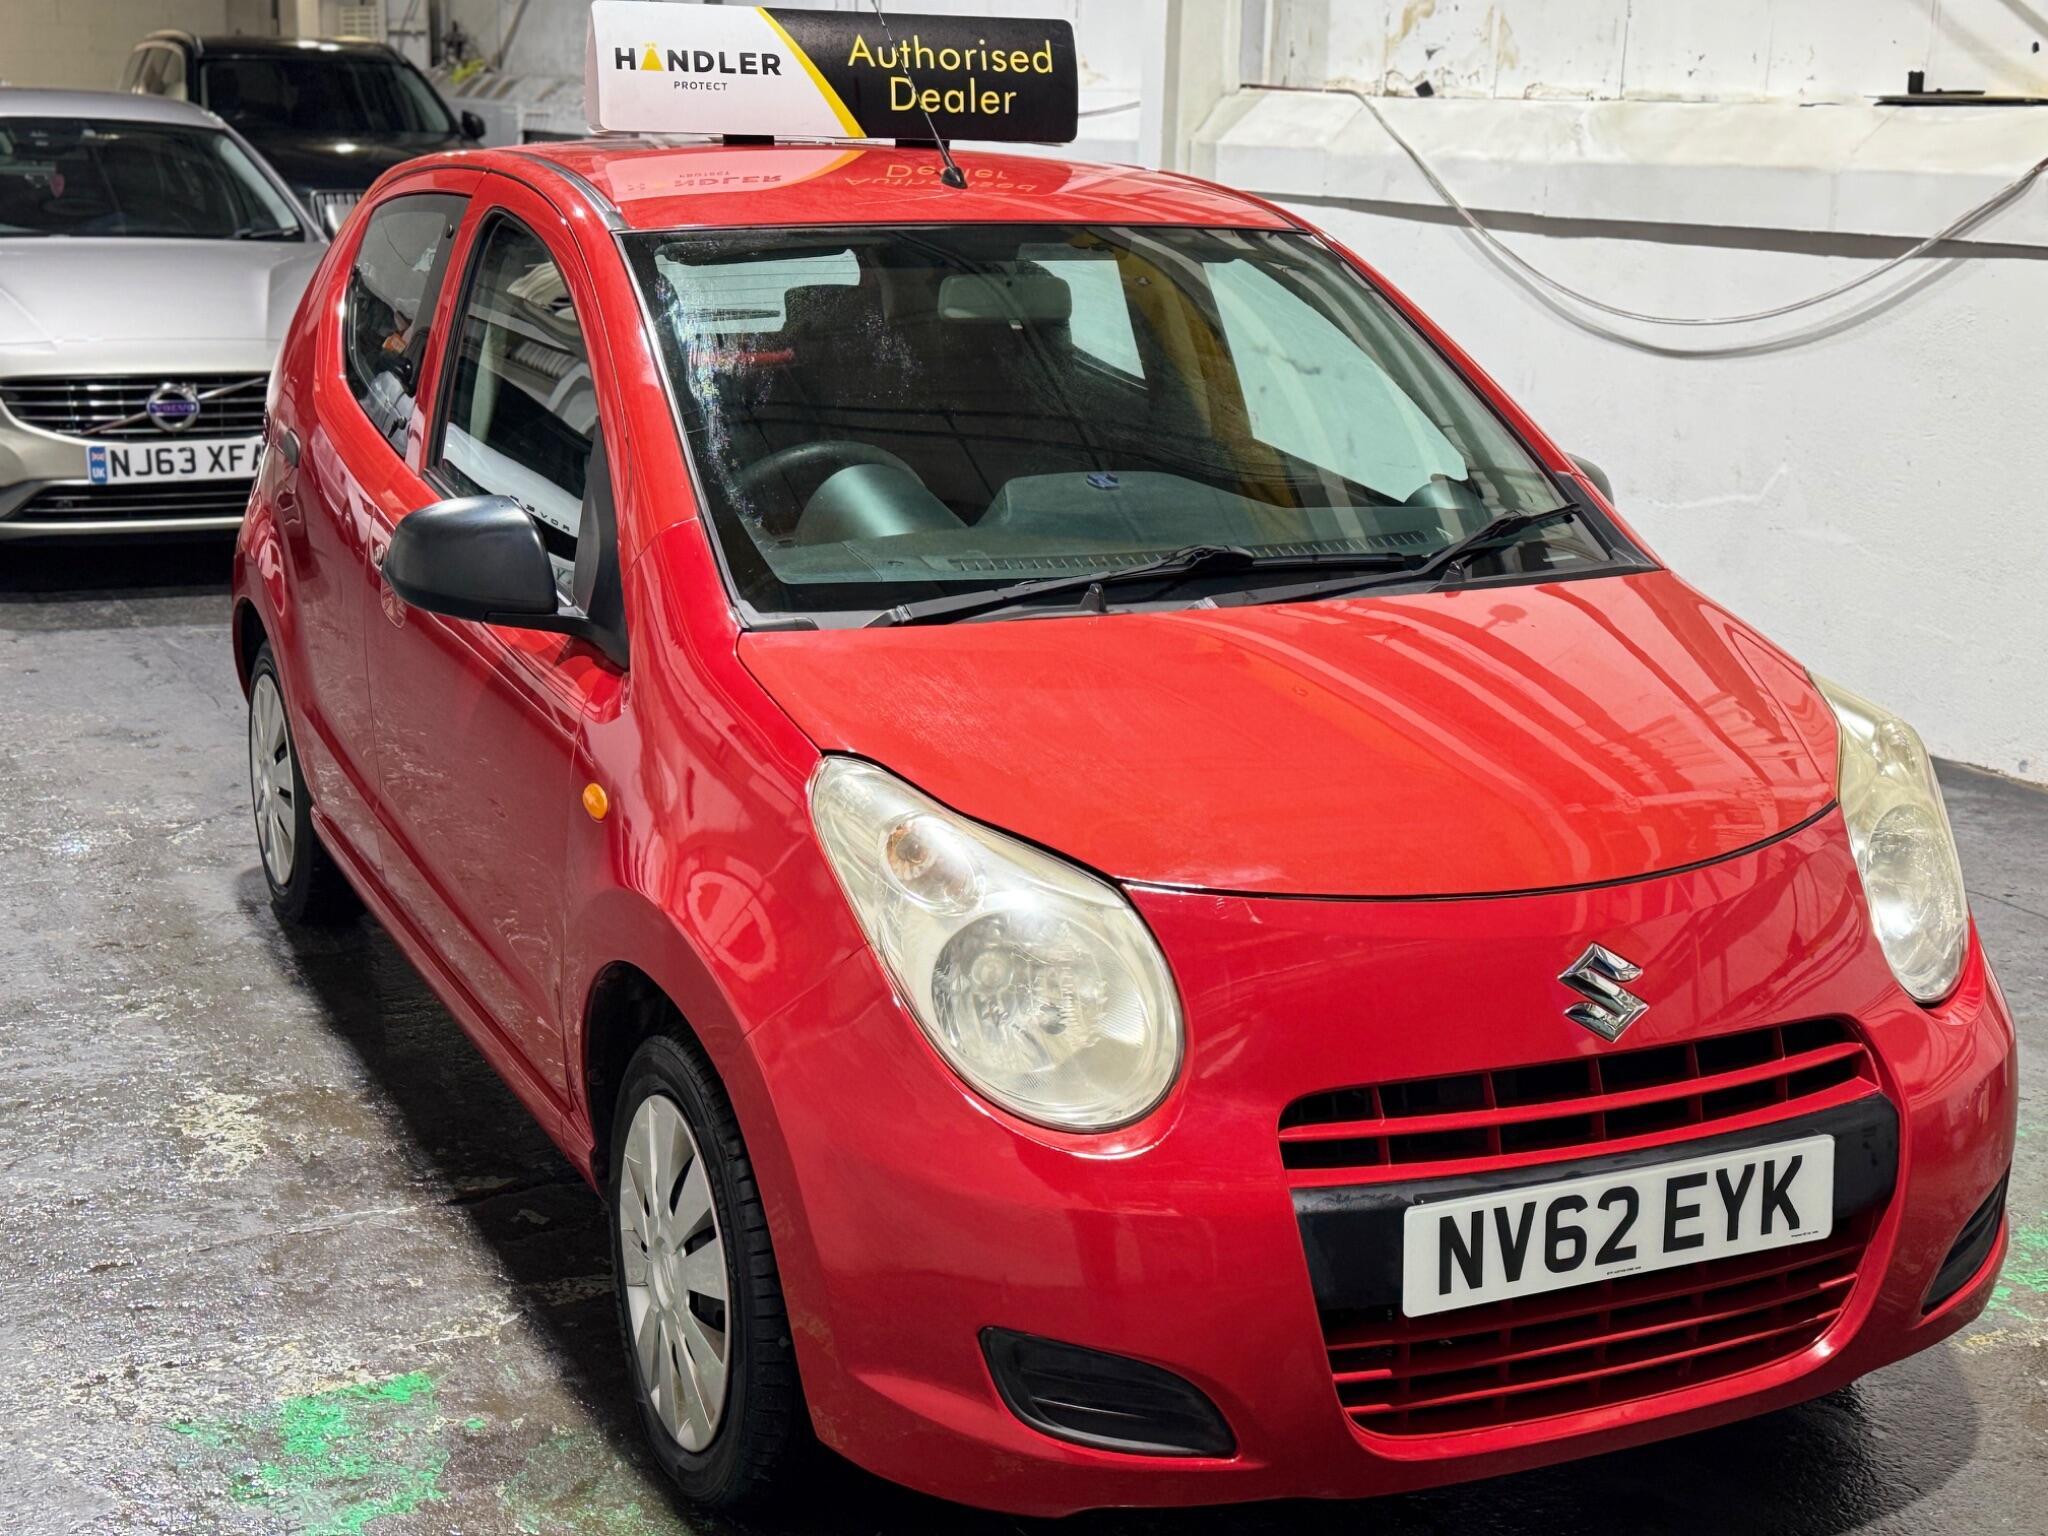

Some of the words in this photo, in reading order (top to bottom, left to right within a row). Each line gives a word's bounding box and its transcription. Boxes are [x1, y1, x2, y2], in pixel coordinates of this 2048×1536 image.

[847, 34, 1053, 74] Authorised
[673, 80, 728, 91] PROTECT
[890, 76, 1017, 114] Dealer
[92, 467, 106, 479] UK
[110, 447, 196, 478] NJ63
[1438, 1185, 1640, 1296] NV62
[1662, 1155, 1803, 1254] EYK
